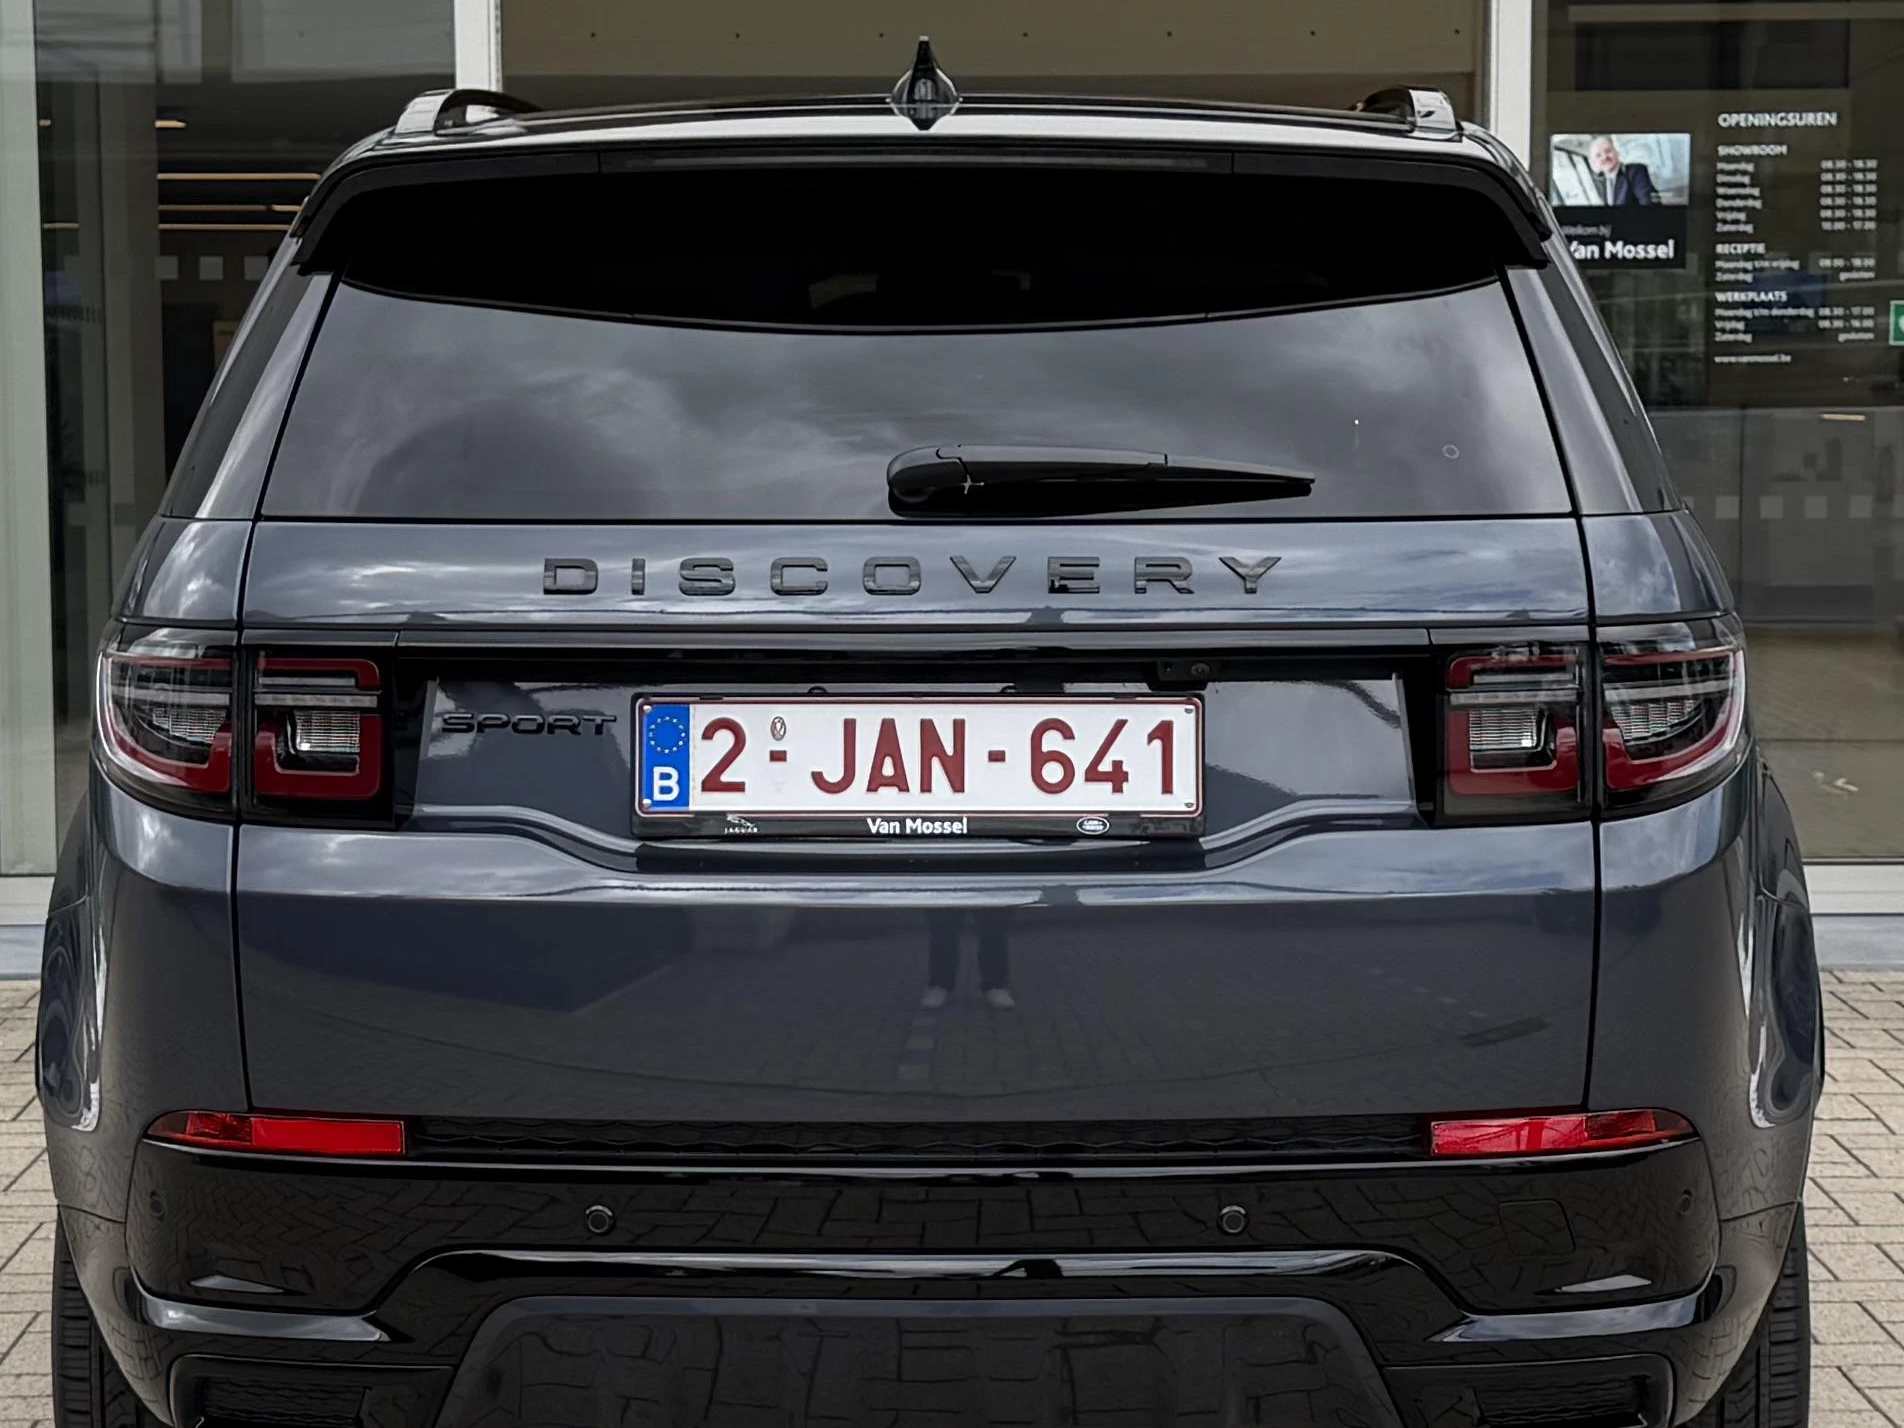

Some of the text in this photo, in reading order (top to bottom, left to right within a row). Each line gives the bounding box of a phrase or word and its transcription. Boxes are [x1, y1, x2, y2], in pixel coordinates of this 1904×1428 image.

[1718, 112, 1837, 127] OPENINGSUREN
[1603, 238, 1675, 259] Mossel
[543, 556, 1282, 595] DISCOVERY
[441, 713, 617, 735] SPORT
[652, 716, 1175, 802] B 2-JAN-641
[866, 815, 968, 834] Van Mossel
